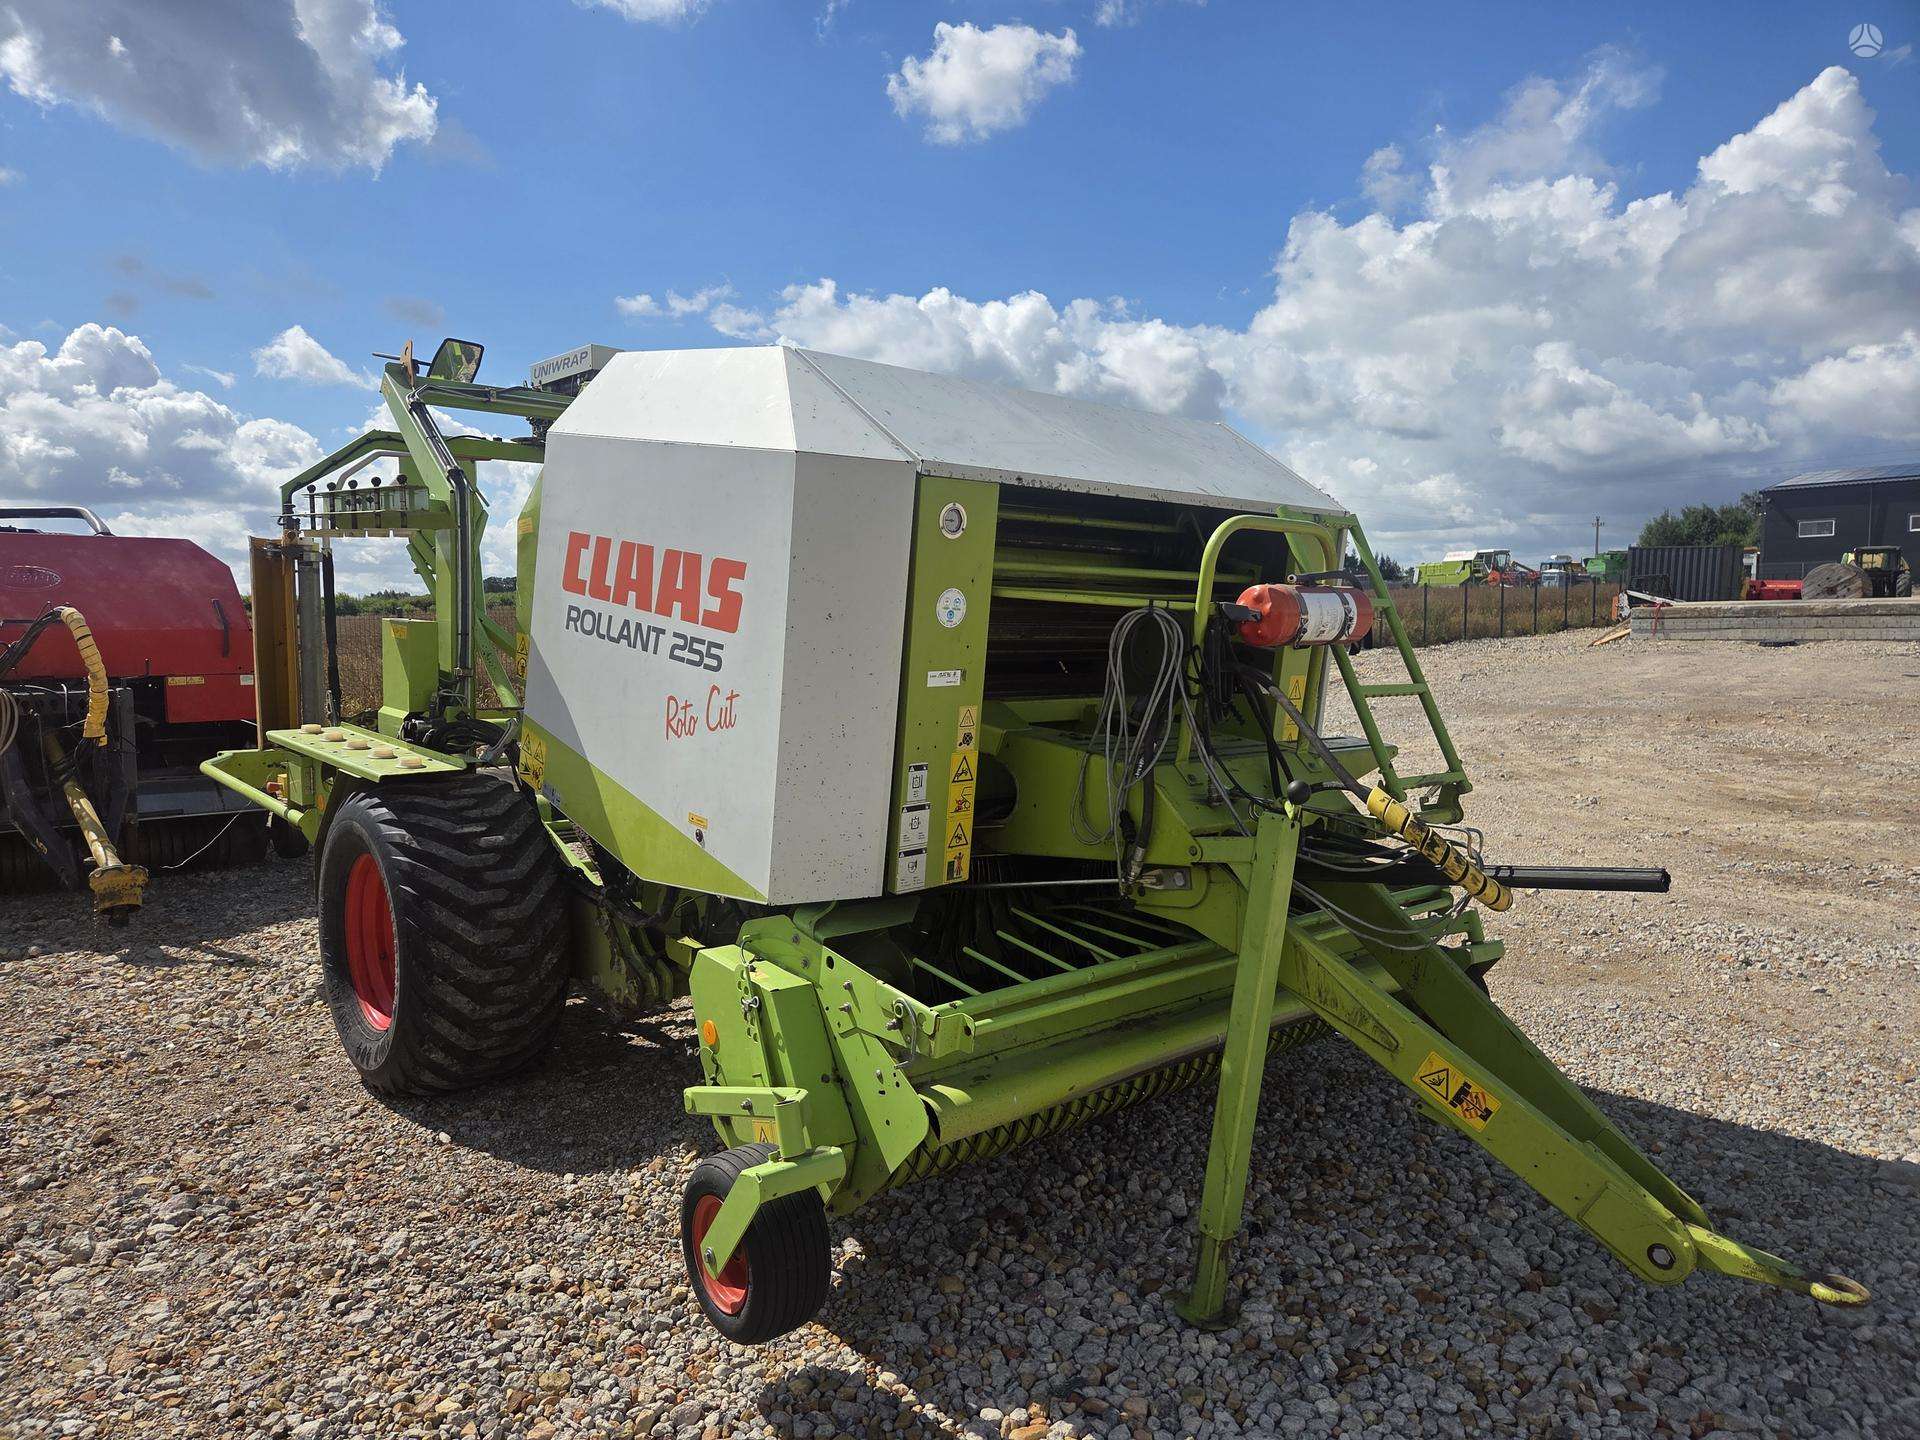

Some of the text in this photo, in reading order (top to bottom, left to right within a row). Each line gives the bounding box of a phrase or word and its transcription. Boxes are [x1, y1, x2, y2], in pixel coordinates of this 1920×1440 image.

[533, 351, 588, 379] UNIWRAP
[562, 531, 747, 634] CLAAS
[565, 604, 724, 673] ROLLANT 255
[666, 684, 740, 741] Roto Cut
